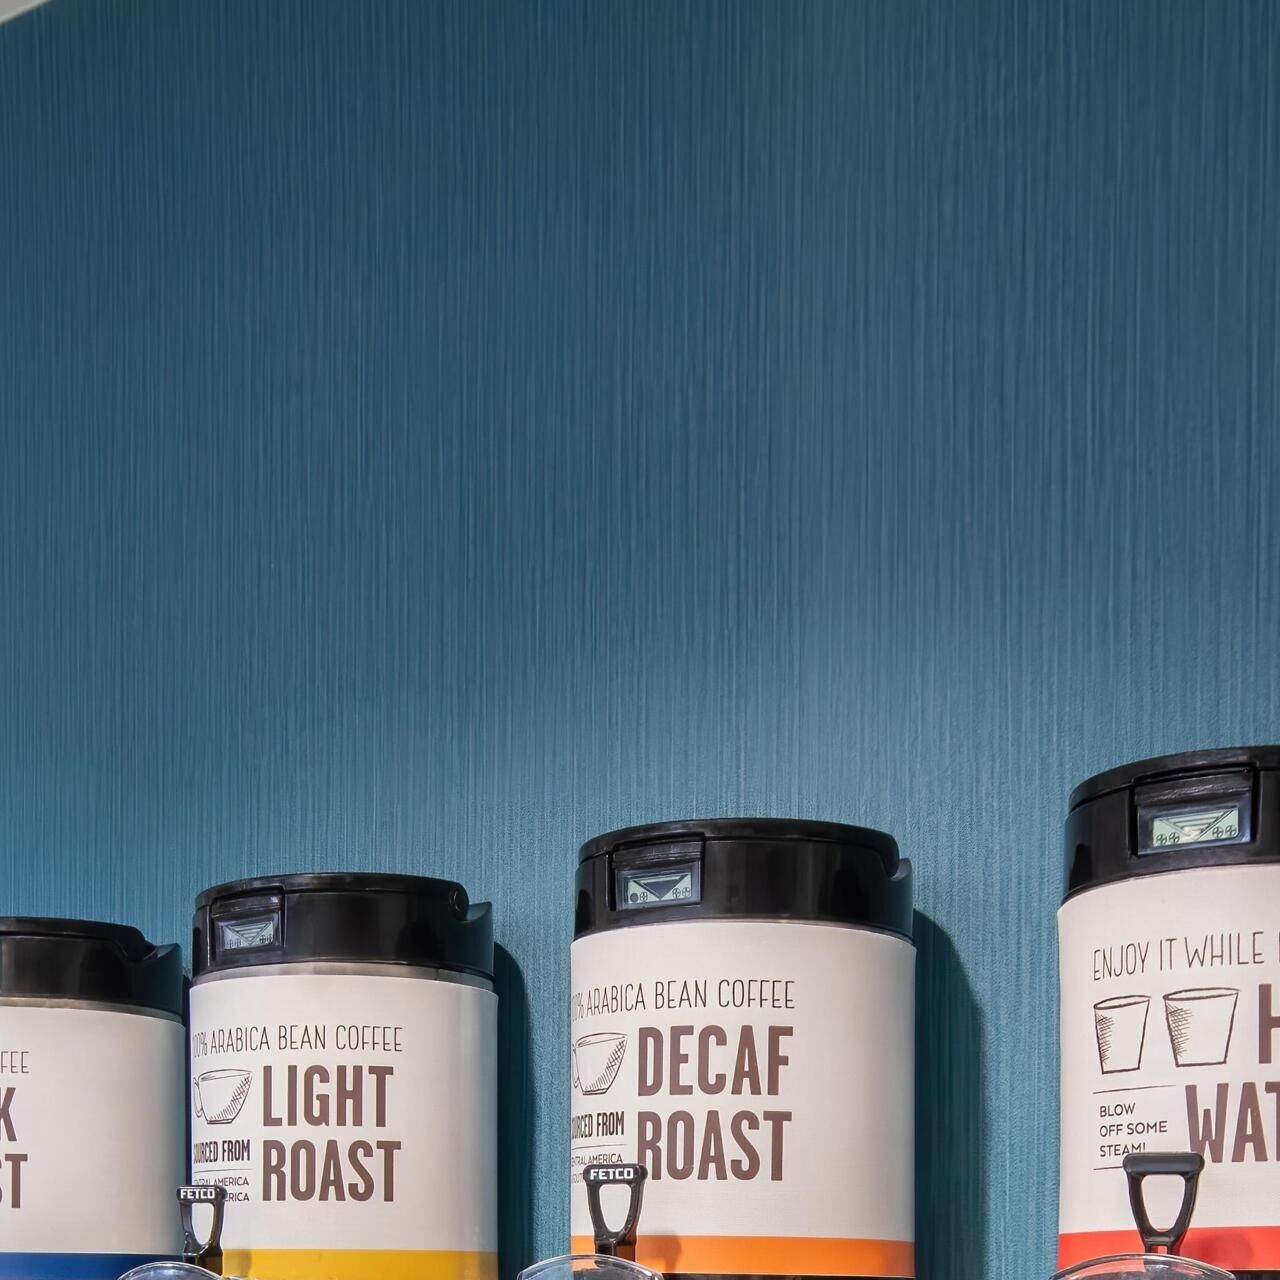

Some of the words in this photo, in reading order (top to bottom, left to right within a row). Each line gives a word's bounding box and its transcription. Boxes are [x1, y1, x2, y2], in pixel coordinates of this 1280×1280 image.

[1093, 942, 1150, 981] ENJOY
[1159, 938, 1177, 971] IT
[1184, 931, 1265, 969] WHILE
[586, 983, 646, 1016] ARABICA
[654, 979, 708, 1010] BEAN
[718, 979, 796, 1009] COFFEE
[210, 1026, 271, 1055] ARABICA
[278, 1025, 327, 1050] BEAN
[335, 1025, 403, 1052] COFFEE
[638, 1025, 794, 1096] DECAF
[263, 1064, 394, 1127] LIGHT
[1099, 1102, 1137, 1118] BLOW
[596, 1111, 625, 1137] FROM
[1099, 1123, 1124, 1137] OFF
[1126, 1120, 1168, 1135] SOME
[221, 1139, 251, 1162] FROM
[637, 1110, 793, 1181] ROAST
[262, 1139, 402, 1202] ROAST
[589, 1168, 634, 1181] FETCO
[179, 1188, 216, 1200] FETCO
